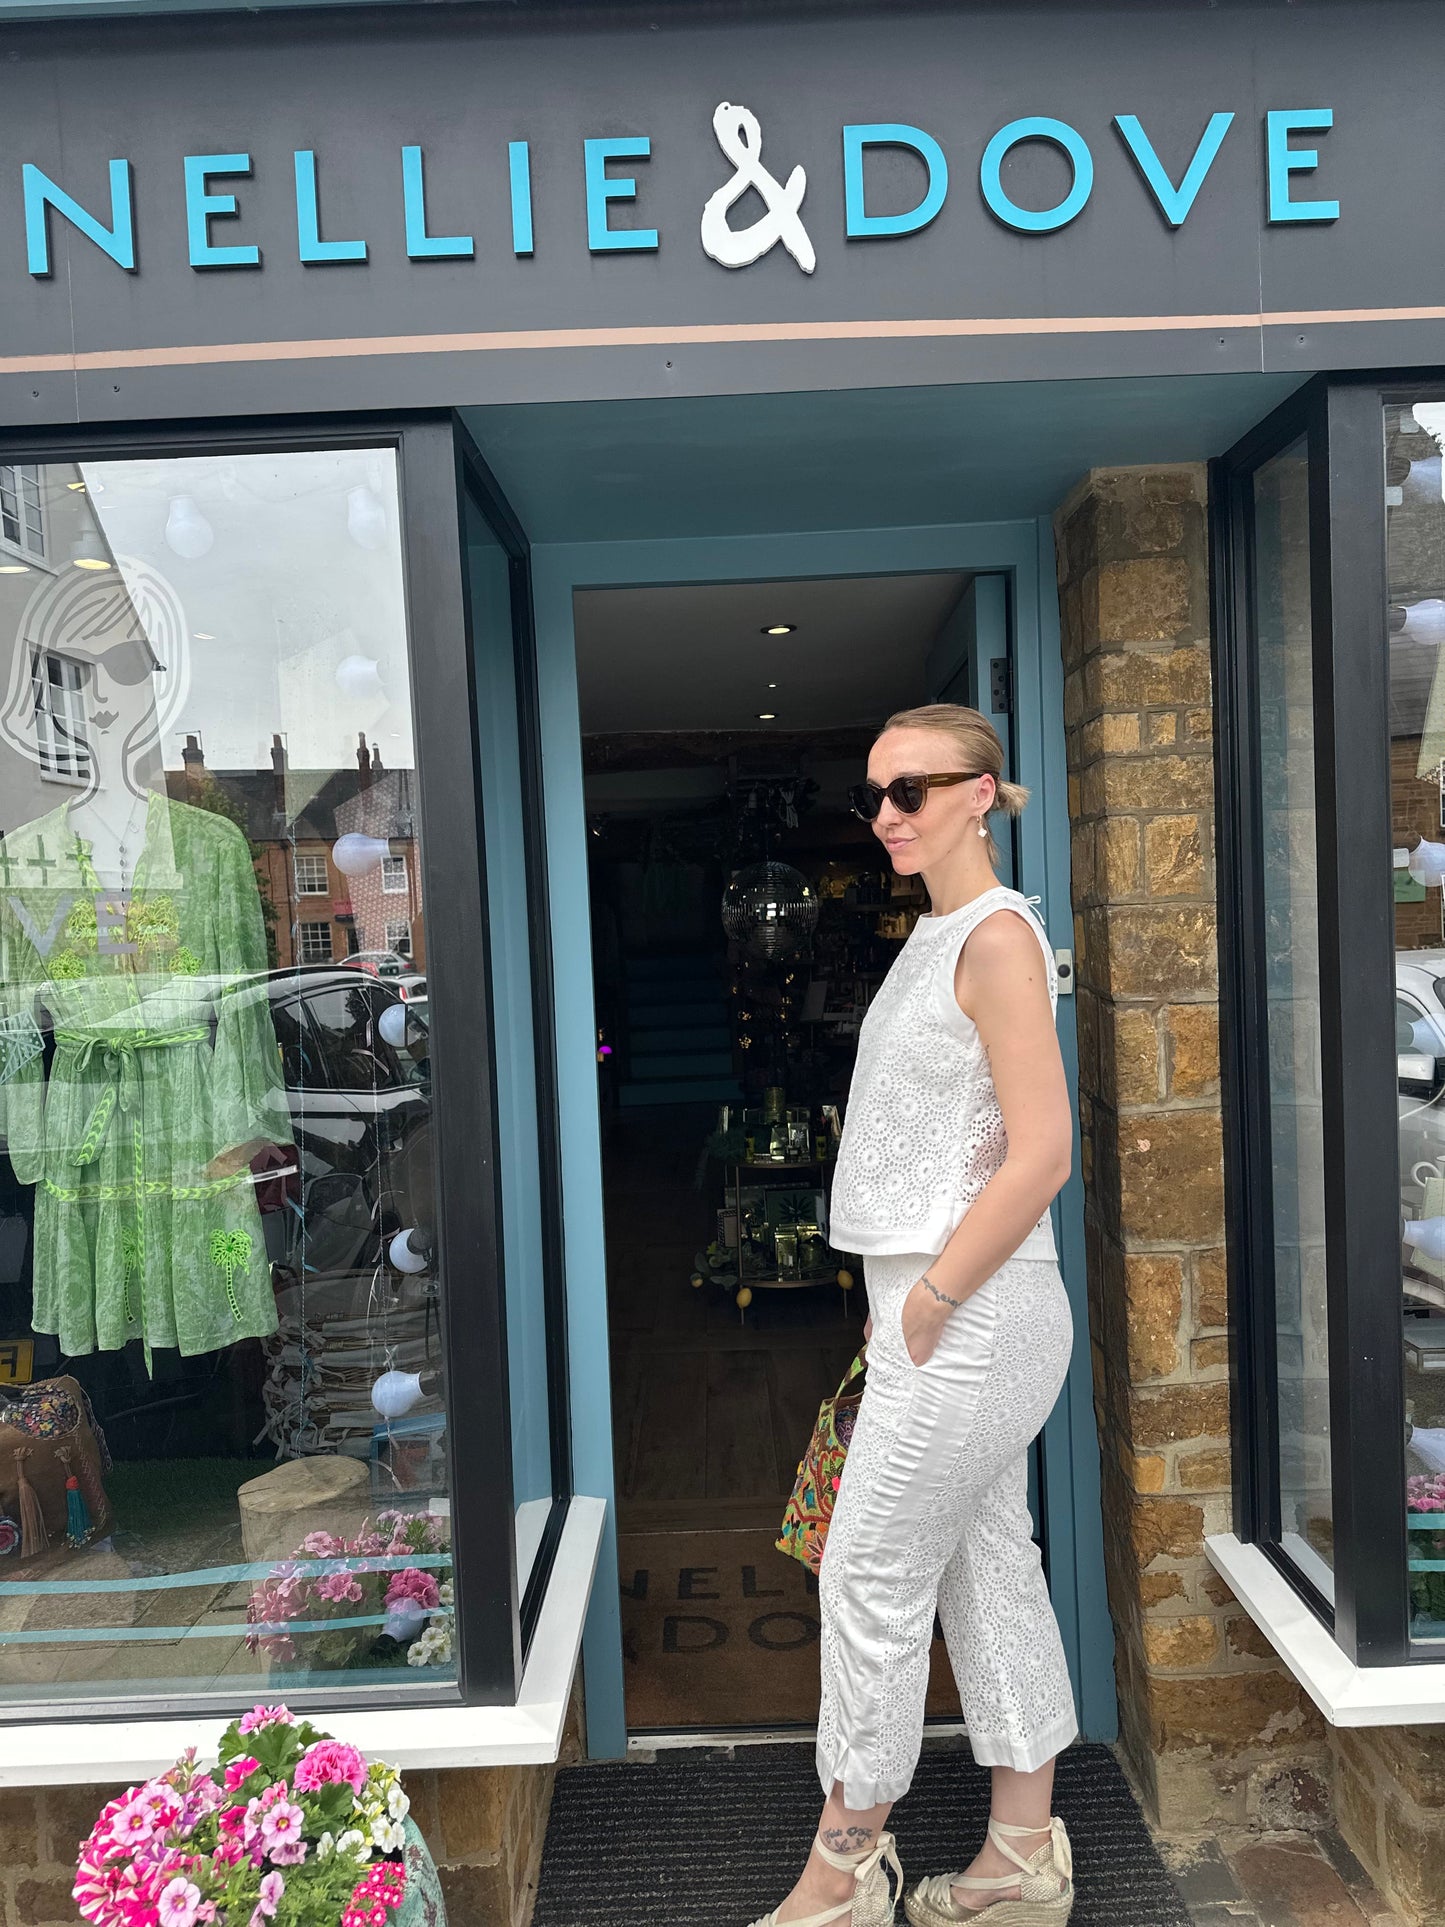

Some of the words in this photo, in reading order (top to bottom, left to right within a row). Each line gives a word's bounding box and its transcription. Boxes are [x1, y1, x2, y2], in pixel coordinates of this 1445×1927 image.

[22, 136, 661, 277] NELLIE
[699, 101, 816, 273] &
[842, 108, 1340, 240] DOVE
